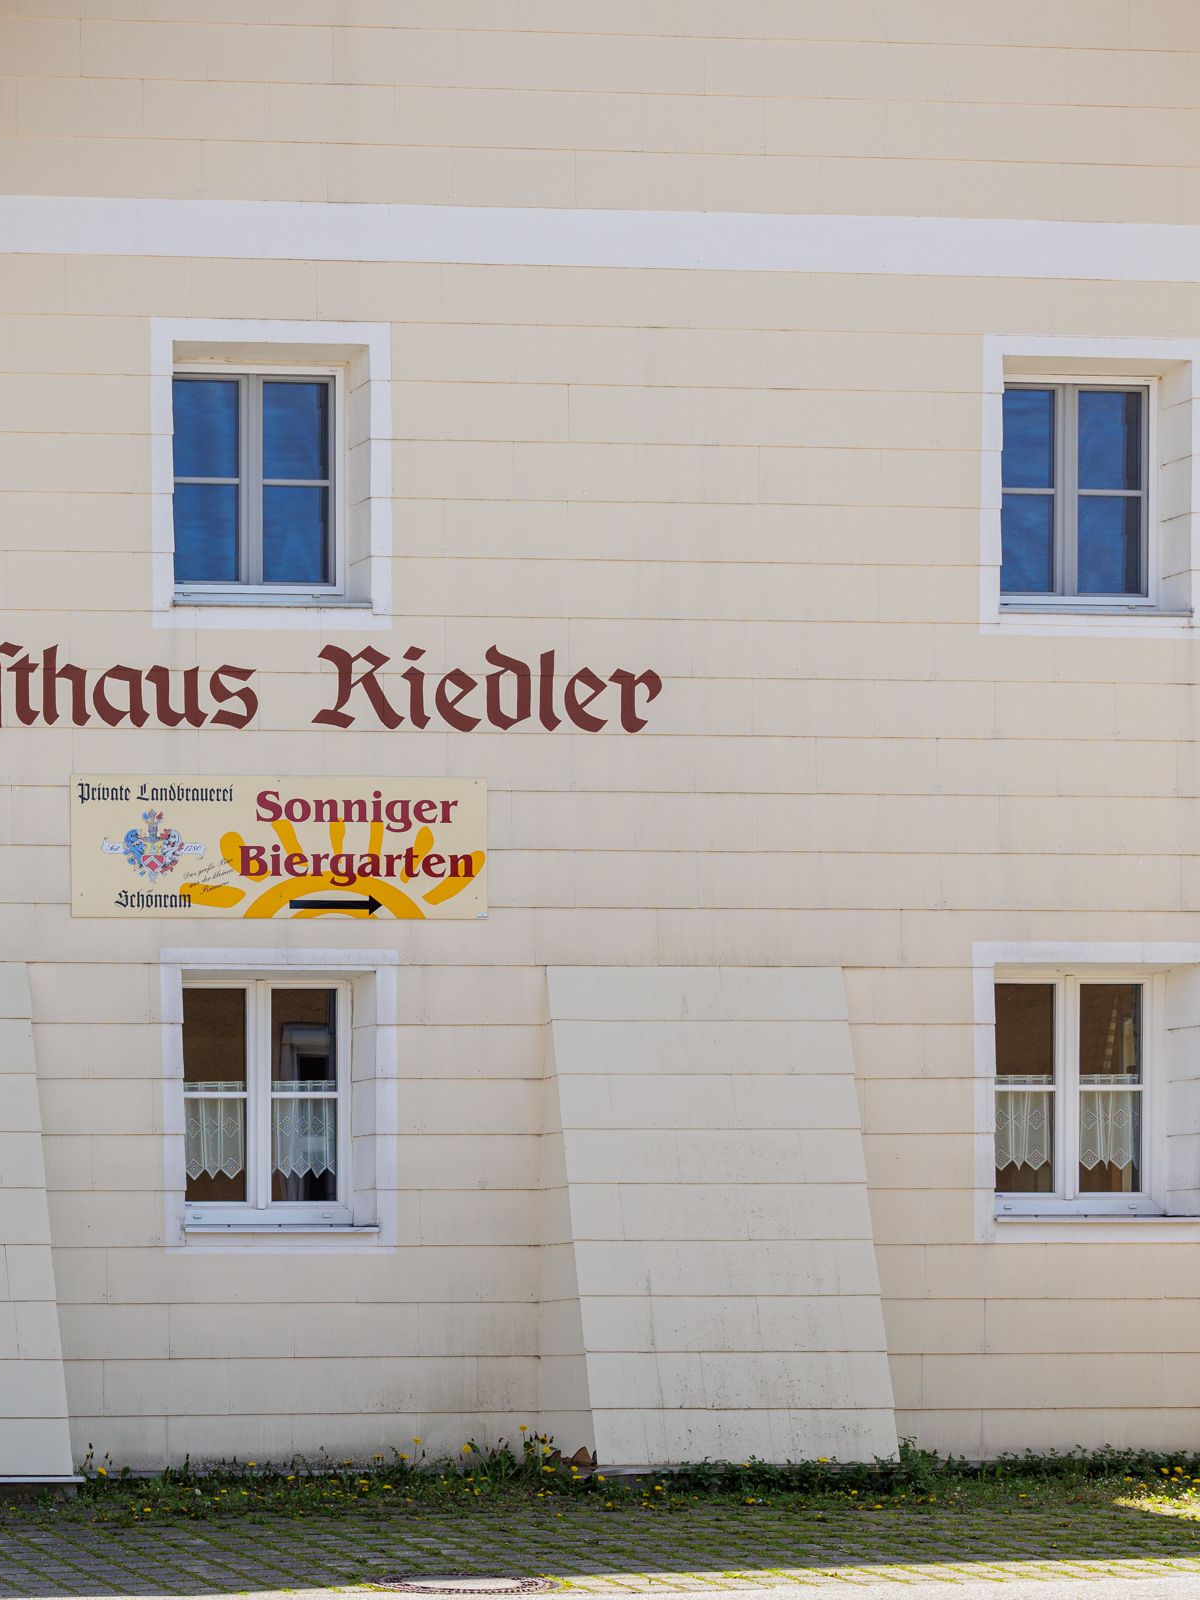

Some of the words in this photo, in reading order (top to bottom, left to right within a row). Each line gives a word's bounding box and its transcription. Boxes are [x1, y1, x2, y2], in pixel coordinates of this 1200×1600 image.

[311, 644, 663, 734] Riedler
[78, 782, 131, 804] Private
[136, 783, 233, 802] Landbrauerei
[256, 790, 459, 833] Sonniger
[238, 843, 476, 887] Biergarten
[114, 889, 192, 912] Schönram
